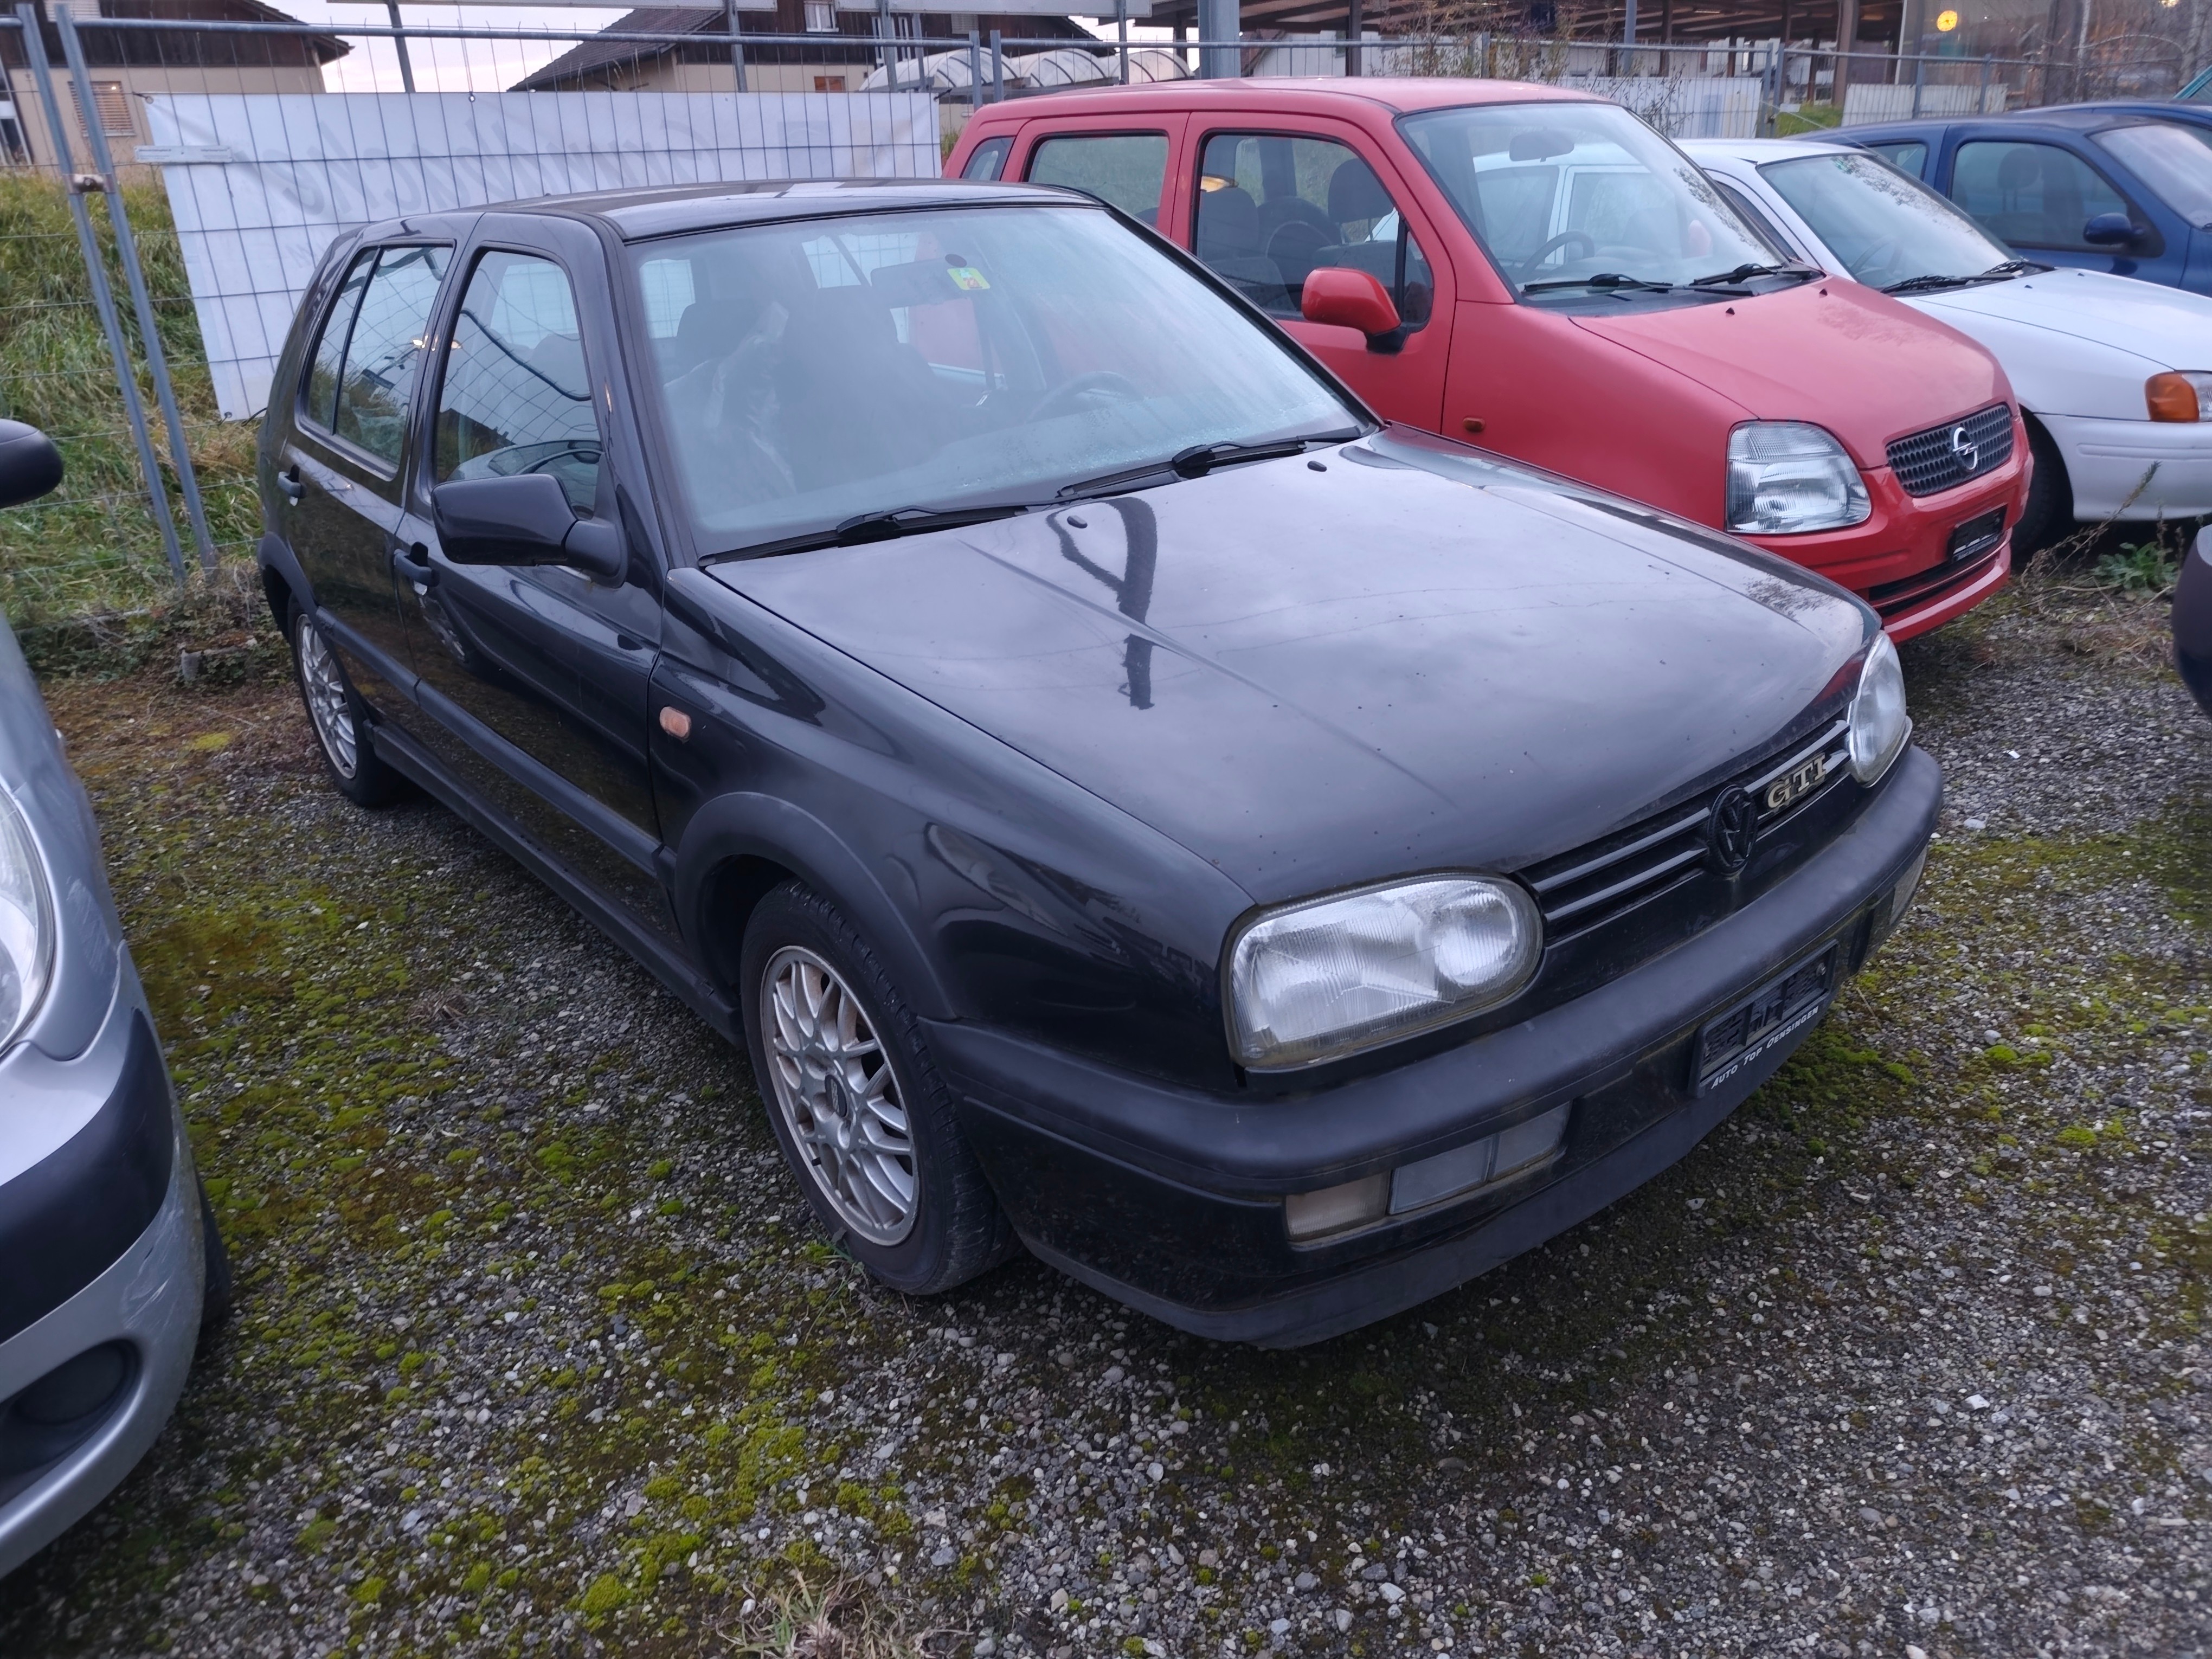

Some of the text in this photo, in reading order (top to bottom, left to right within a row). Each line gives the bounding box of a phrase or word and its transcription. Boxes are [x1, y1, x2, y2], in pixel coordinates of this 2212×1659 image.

[1768, 754, 1826, 808] GTI
[1711, 1005, 1819, 1090] AUTO TOP OENSINGEN
